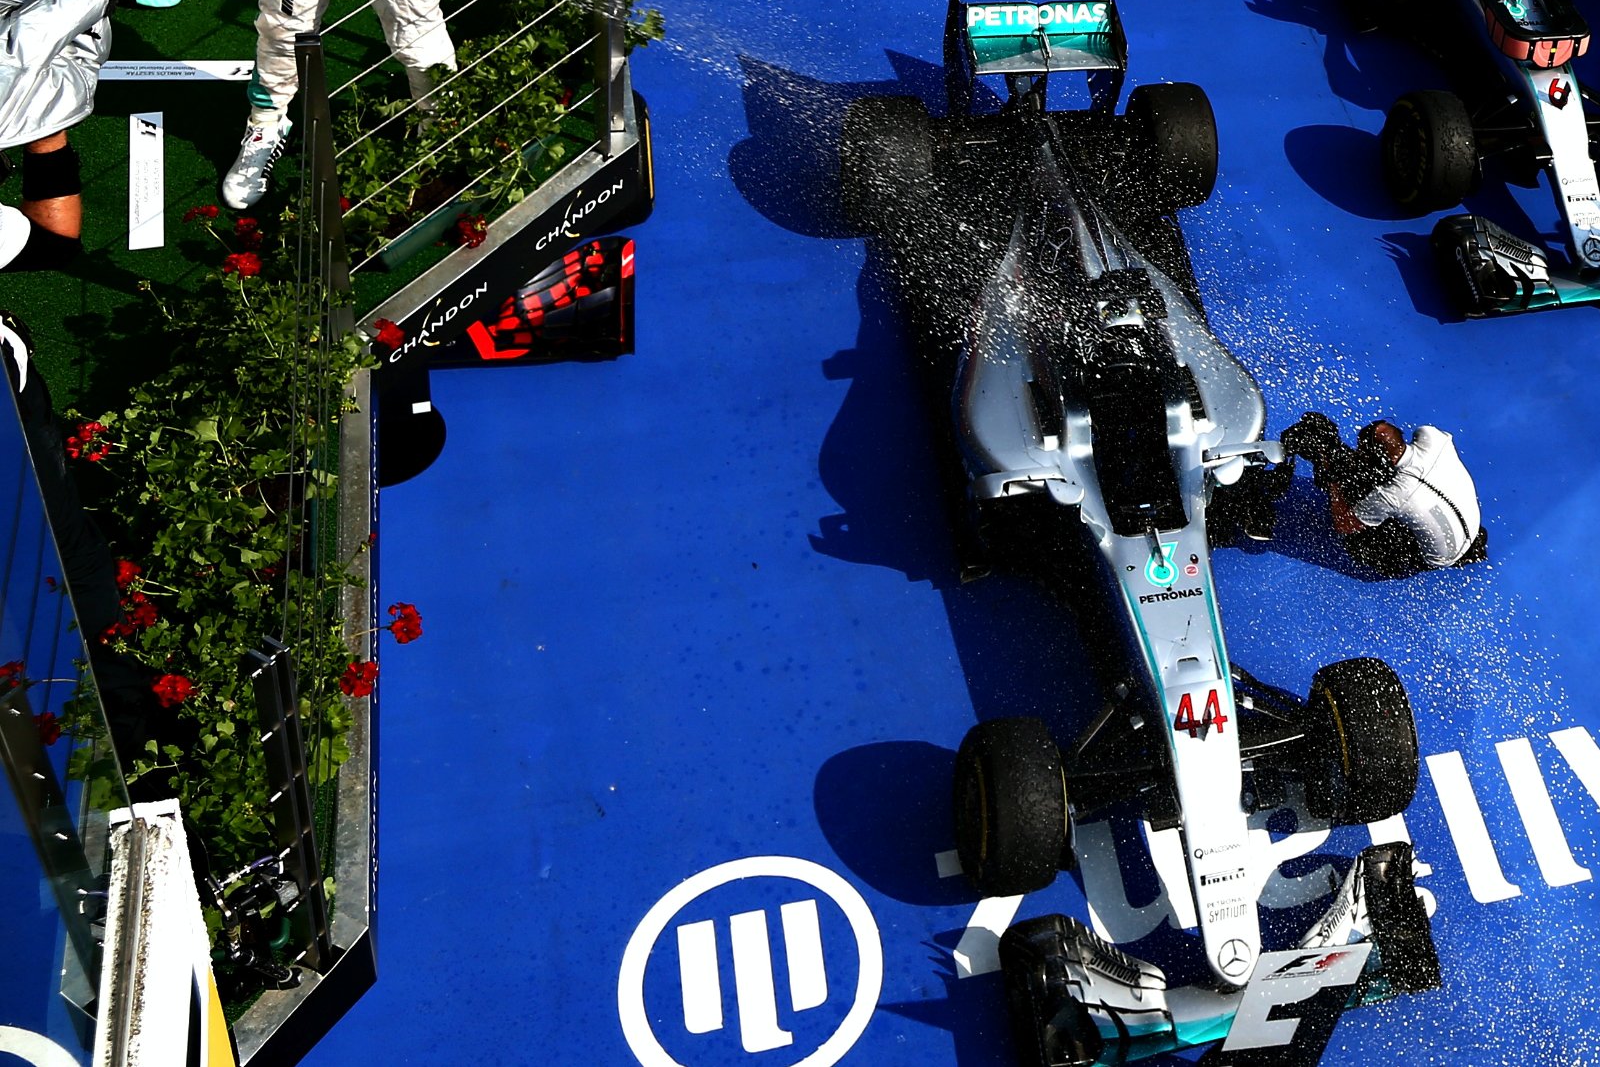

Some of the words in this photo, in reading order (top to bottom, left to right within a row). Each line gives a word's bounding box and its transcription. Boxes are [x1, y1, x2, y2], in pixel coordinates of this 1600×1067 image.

[968, 3, 1107, 27] PETRONAS
[535, 179, 623, 251] CHANDON
[389, 281, 488, 363] CHANDON
[1139, 587, 1203, 605] PETRONAS
[1174, 689, 1228, 738] 44
[1194, 843, 1241, 860] QUALCOMM
[1200, 867, 1245, 886] PIRELLI
[1208, 903, 1247, 923] SYNTIUM
